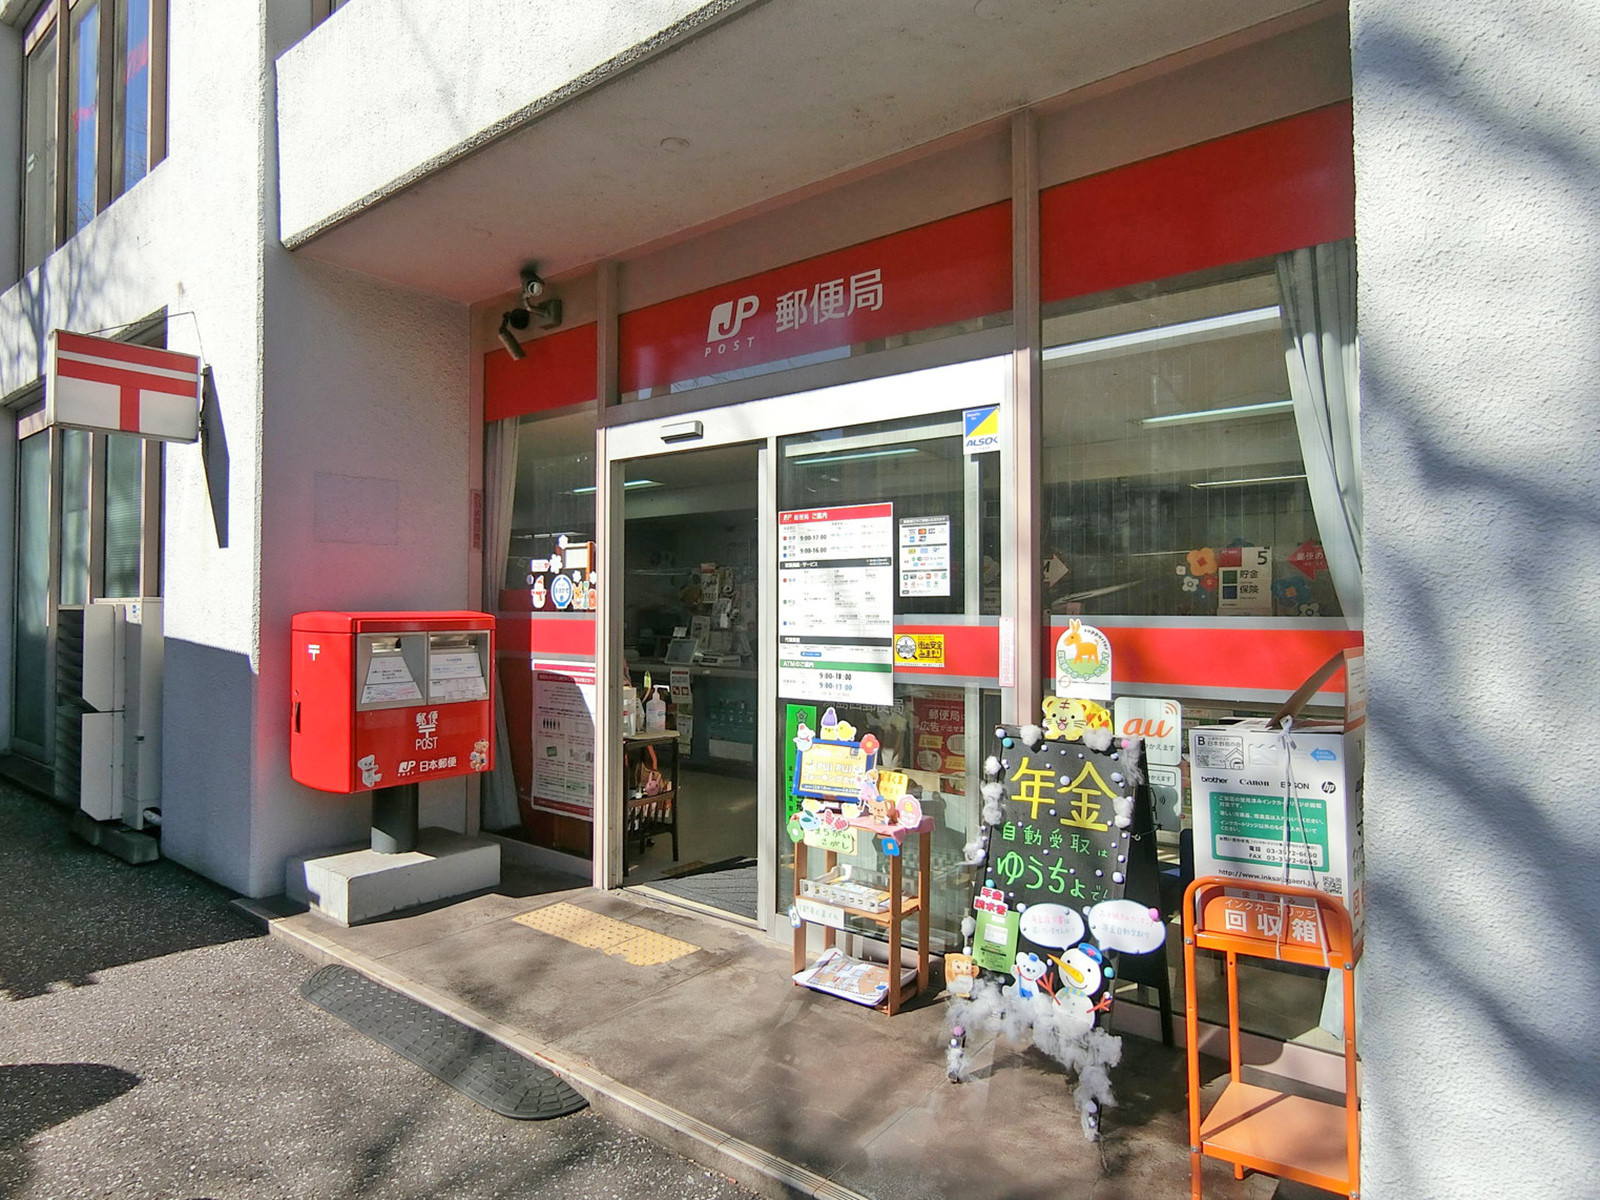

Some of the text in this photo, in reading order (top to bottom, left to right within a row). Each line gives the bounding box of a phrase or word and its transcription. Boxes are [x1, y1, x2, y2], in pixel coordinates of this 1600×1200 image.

[775, 268, 883, 333] 郵便局
[704, 336, 755, 358] POST
[966, 436, 998, 447] ALSOK
[1257, 551, 1267, 565] 5
[1240, 570, 1258, 579] 貯金
[1240, 585, 1259, 594] 保険
[415, 711, 439, 725] 郵便
[1123, 718, 1173, 738] au
[415, 737, 438, 750] POST
[419, 756, 457, 772] 日本郵便
[1201, 776, 1228, 784] brother
[1239, 778, 1270, 787] Canon
[1010, 757, 1117, 832] 年金
[1322, 781, 1336, 794] hp
[1002, 821, 1108, 858] 自動受取は
[1225, 908, 1317, 943] 回収箱
